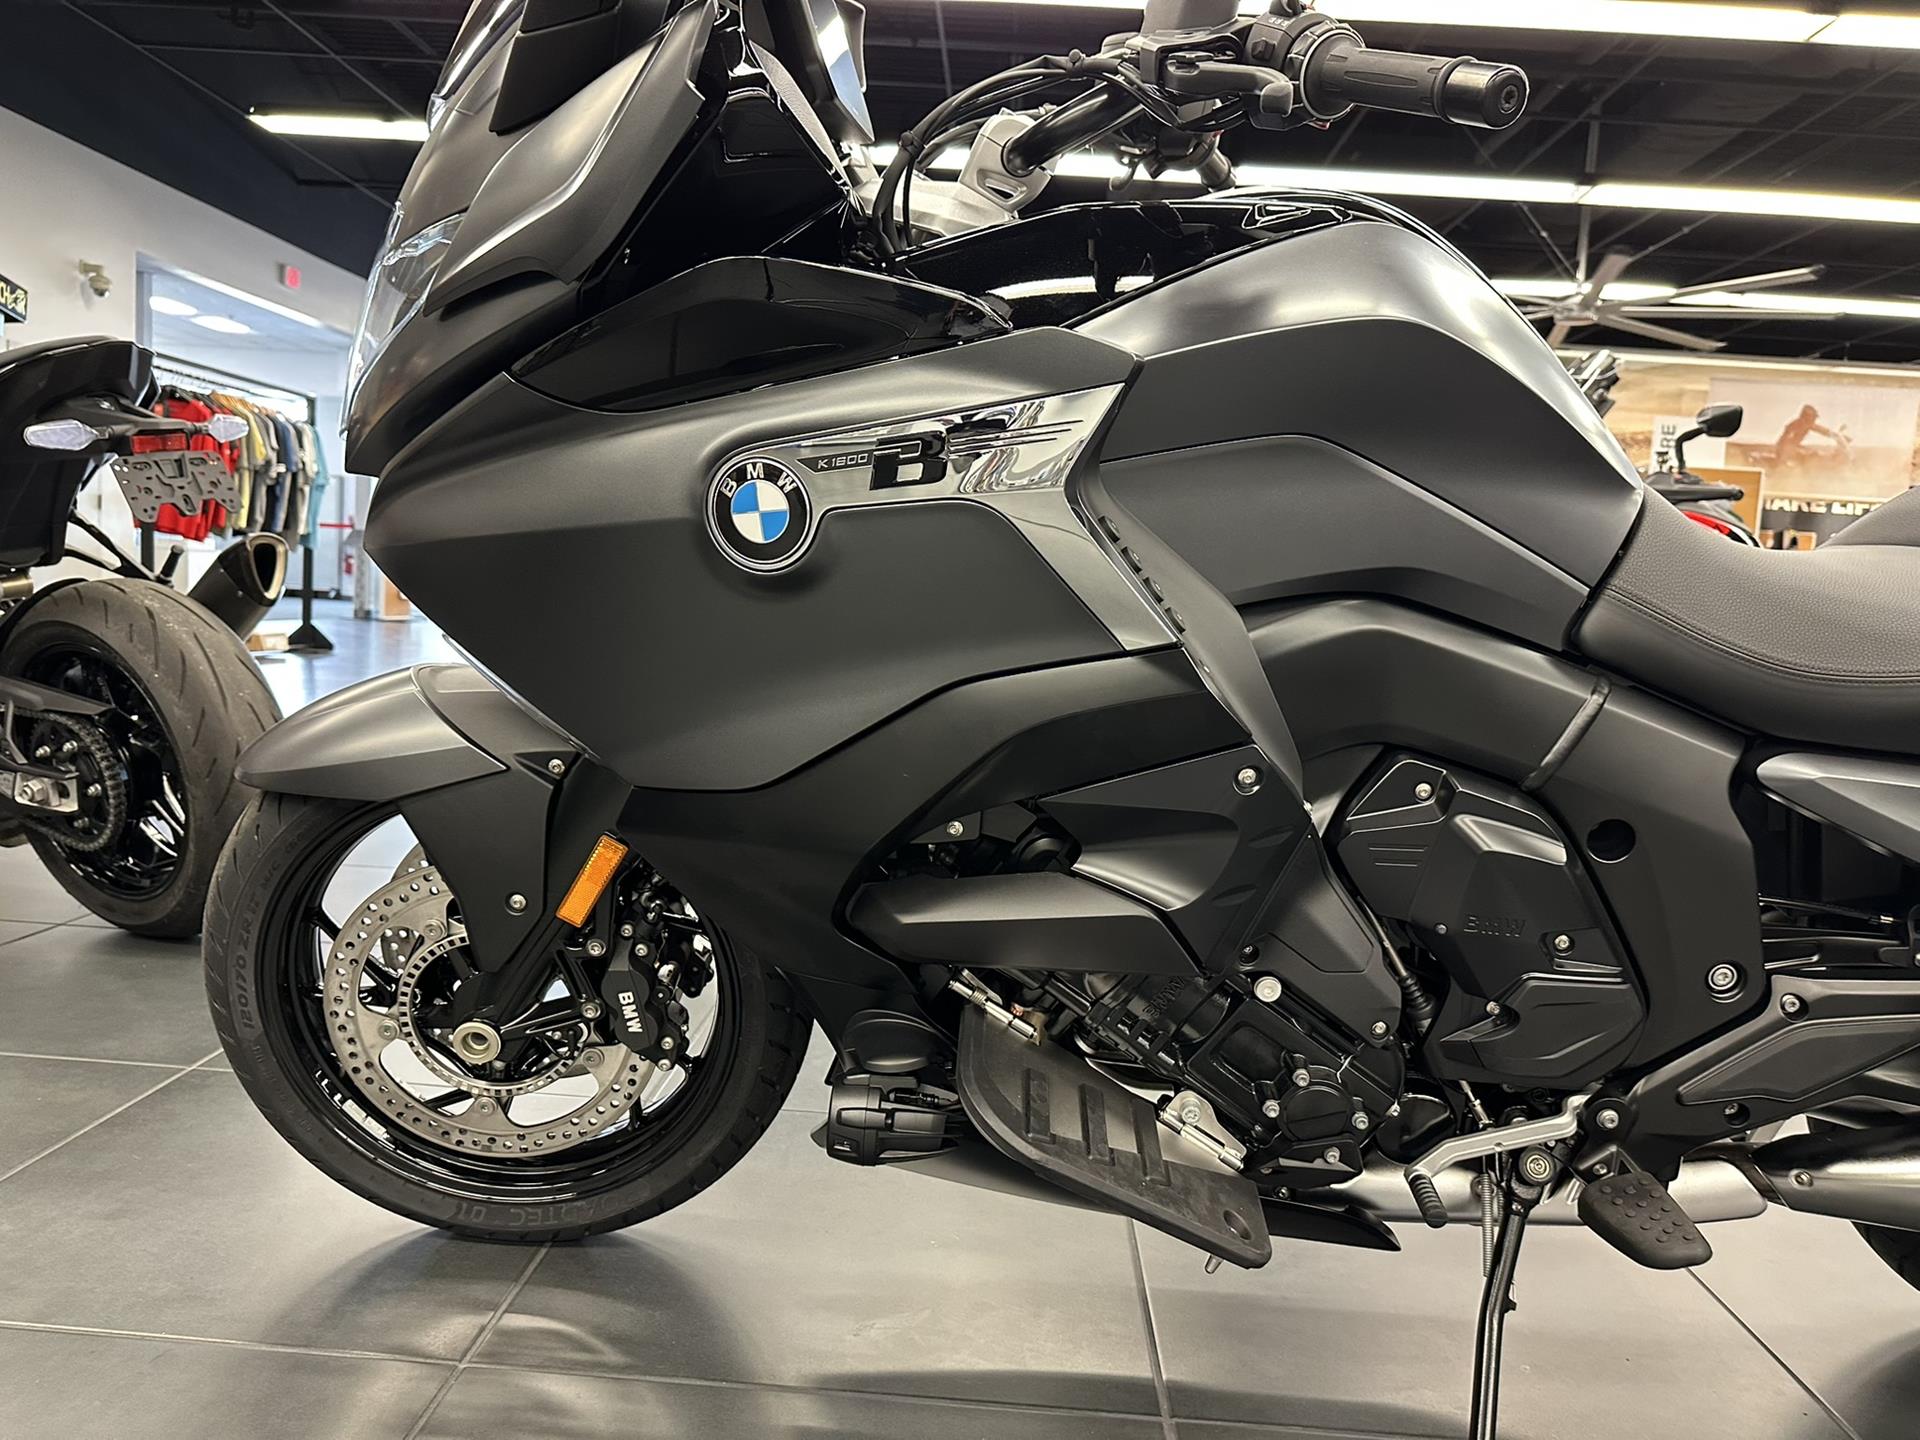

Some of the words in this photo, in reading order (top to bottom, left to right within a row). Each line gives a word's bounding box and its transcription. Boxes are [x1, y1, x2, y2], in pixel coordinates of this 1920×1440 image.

[817, 459, 829, 469] K
[831, 453, 869, 468] 1600
[719, 463, 798, 499] BMW
[1463, 914, 1527, 938] BMW
[618, 991, 643, 1032] BMW
